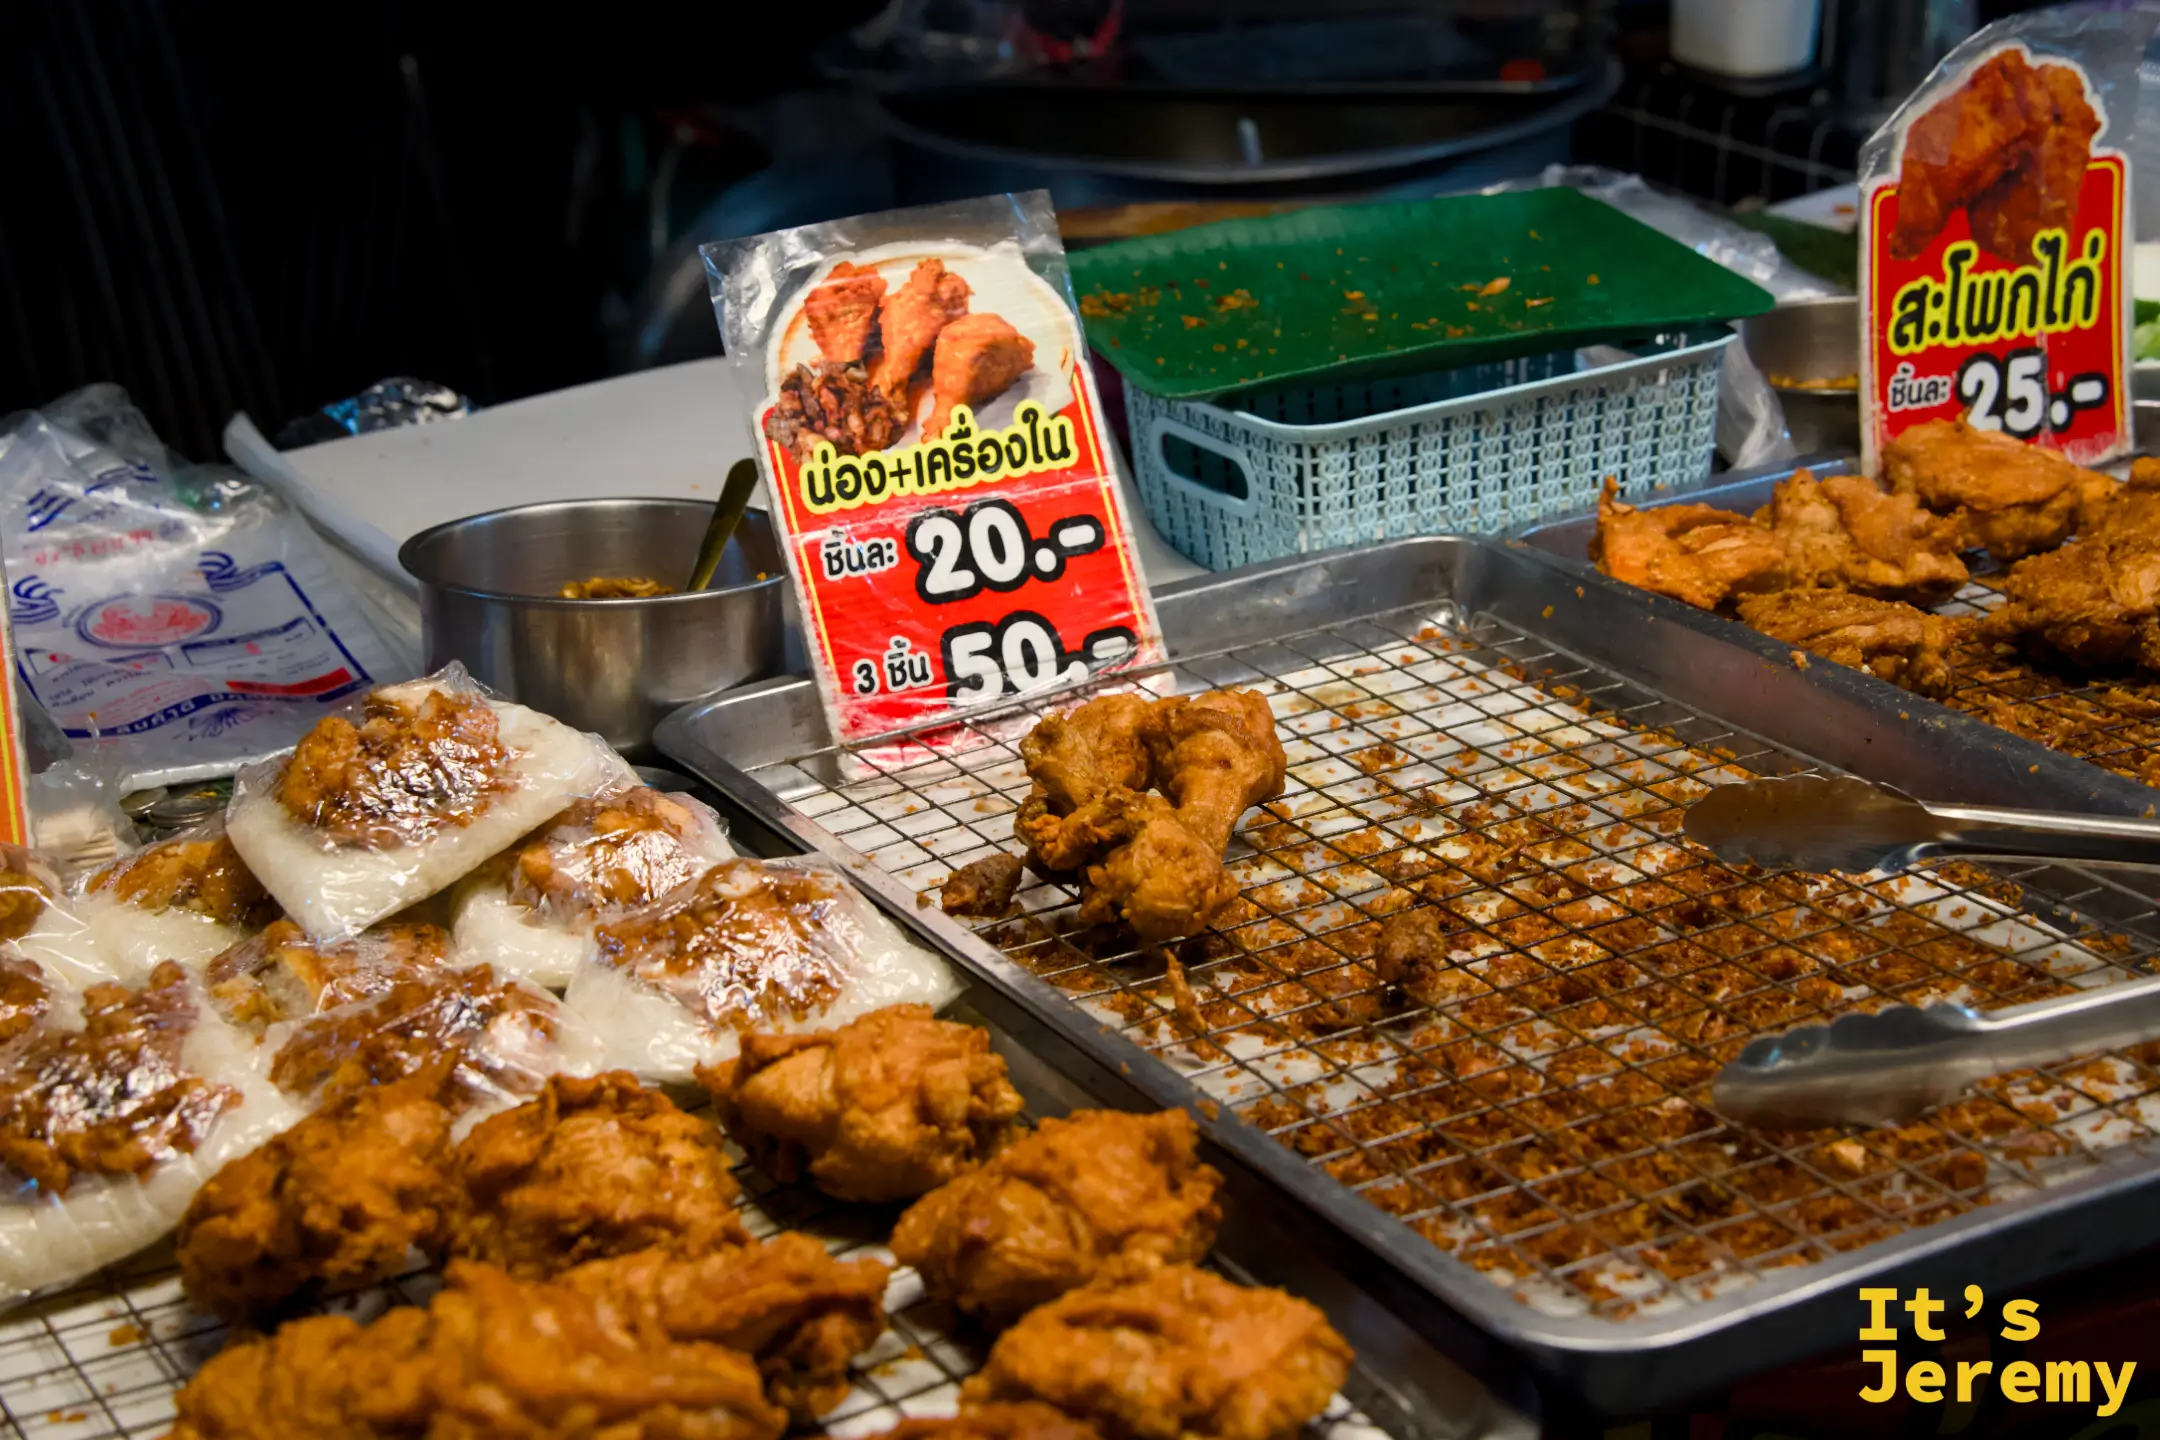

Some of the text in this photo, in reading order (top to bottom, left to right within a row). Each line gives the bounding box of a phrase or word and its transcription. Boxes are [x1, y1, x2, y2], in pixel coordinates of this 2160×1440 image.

[1892, 234, 2100, 347] สะโพกไก่
[1891, 353, 2105, 434] ชิ้นละ 25.-
[805, 407, 1072, 507] น่อง+เครื่องใน
[823, 503, 1098, 597] ชิ้นละ 20.-
[855, 617, 1130, 707] 3 ชิ้น 50.-
